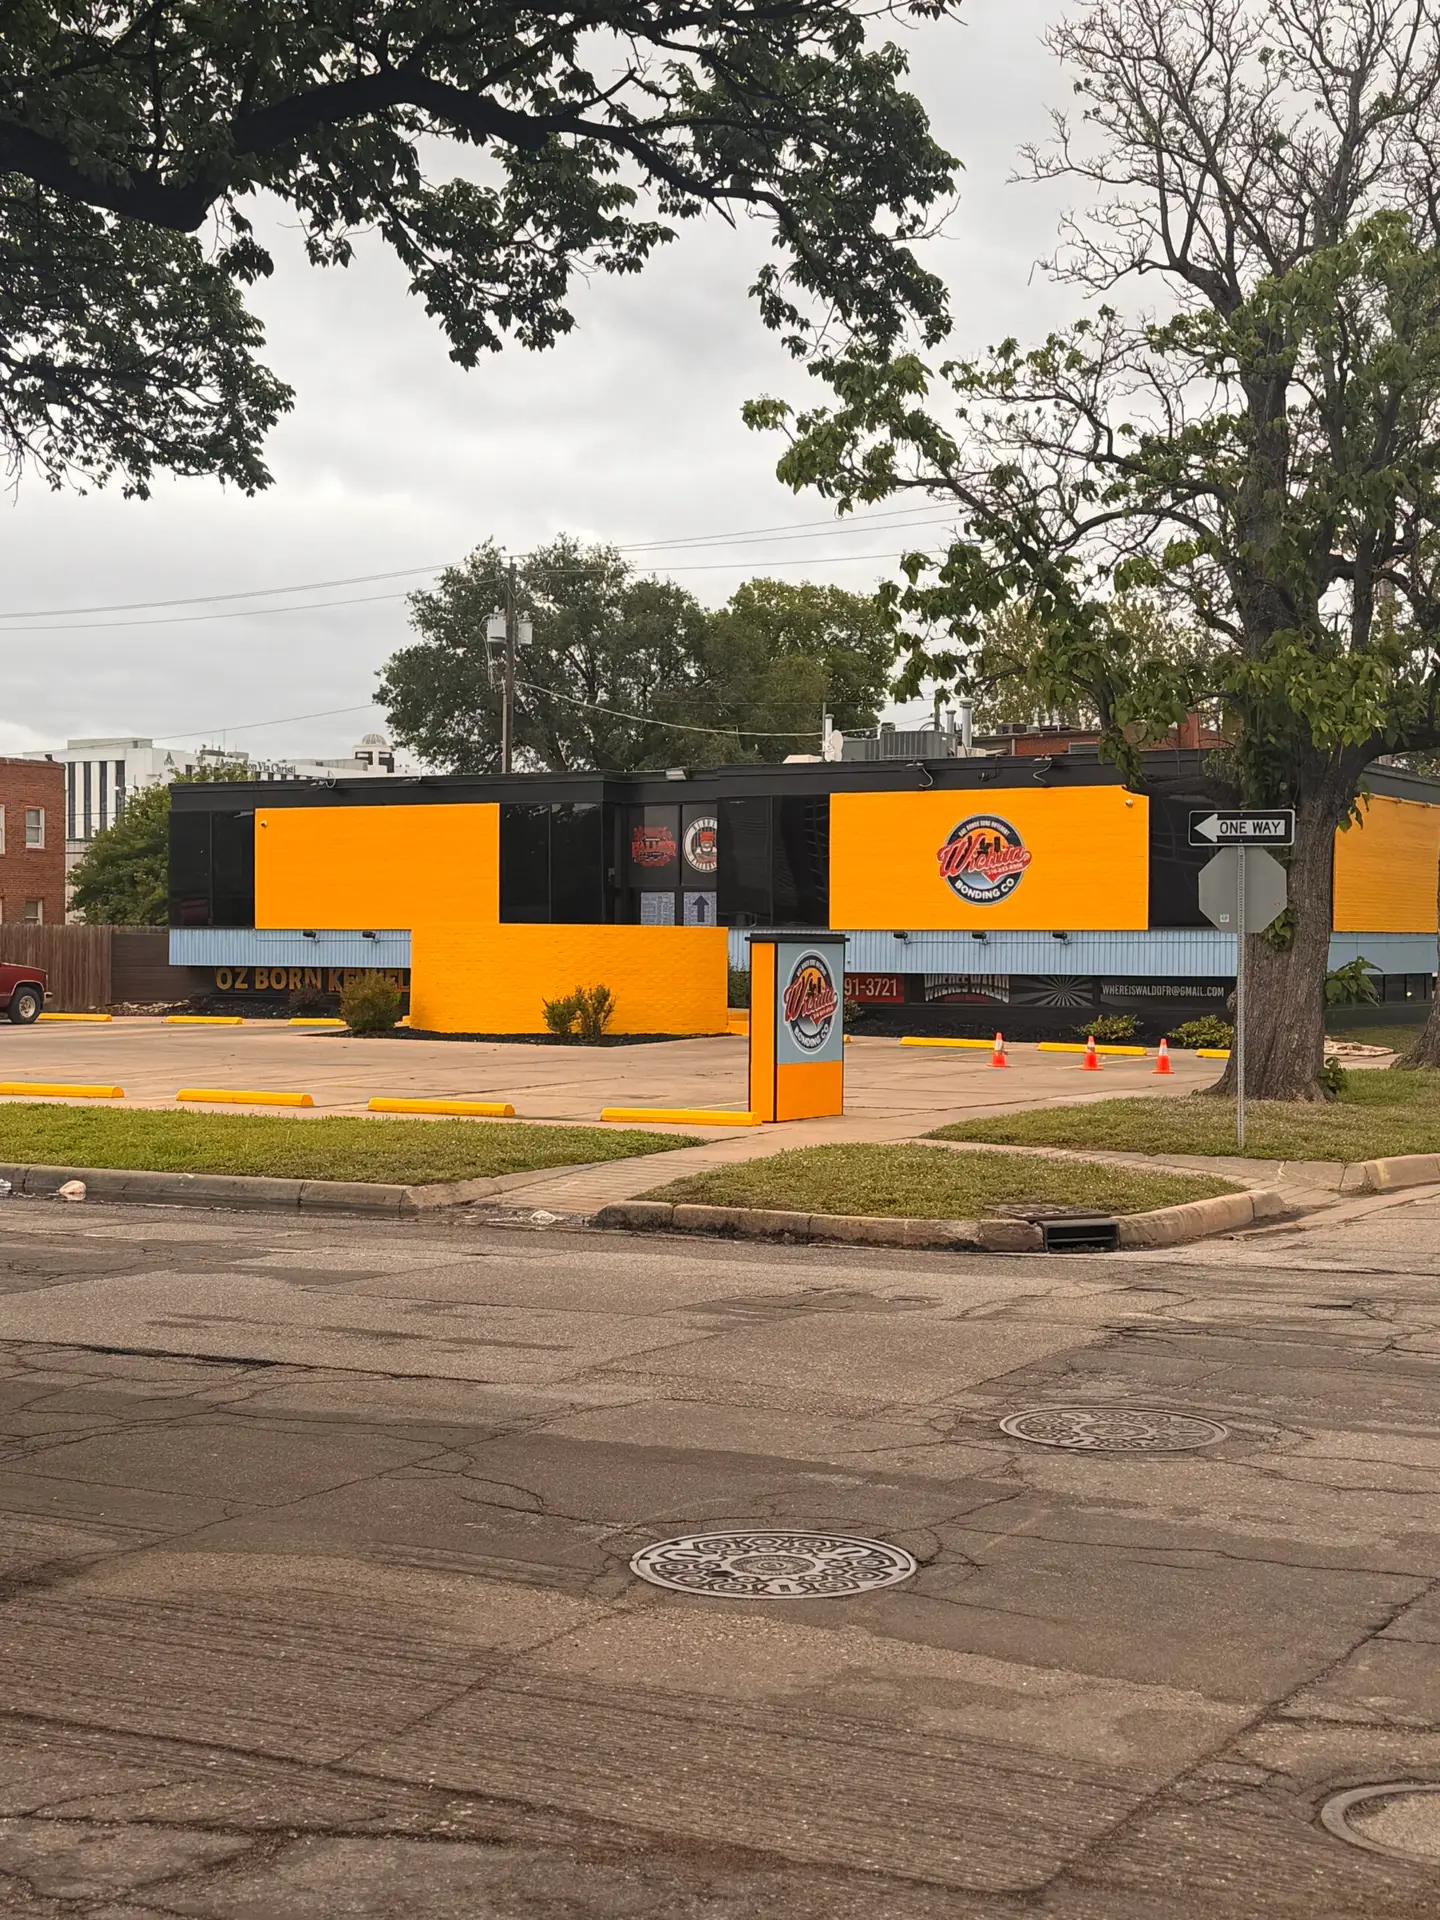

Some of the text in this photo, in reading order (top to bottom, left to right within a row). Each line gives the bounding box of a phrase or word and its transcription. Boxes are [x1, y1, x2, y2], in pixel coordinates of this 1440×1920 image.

[219, 758, 296, 775] Ascenon Via Christi
[1220, 822, 1281, 834] ONE WAY
[937, 833, 1031, 878] Wichita
[955, 878, 1015, 900] BONDING CO
[216, 967, 410, 992] OZ BORN KEEL
[844, 978, 897, 996] 91-3721
[784, 973, 837, 1023] Wichita
[794, 1024, 829, 1047] BONDING CO
